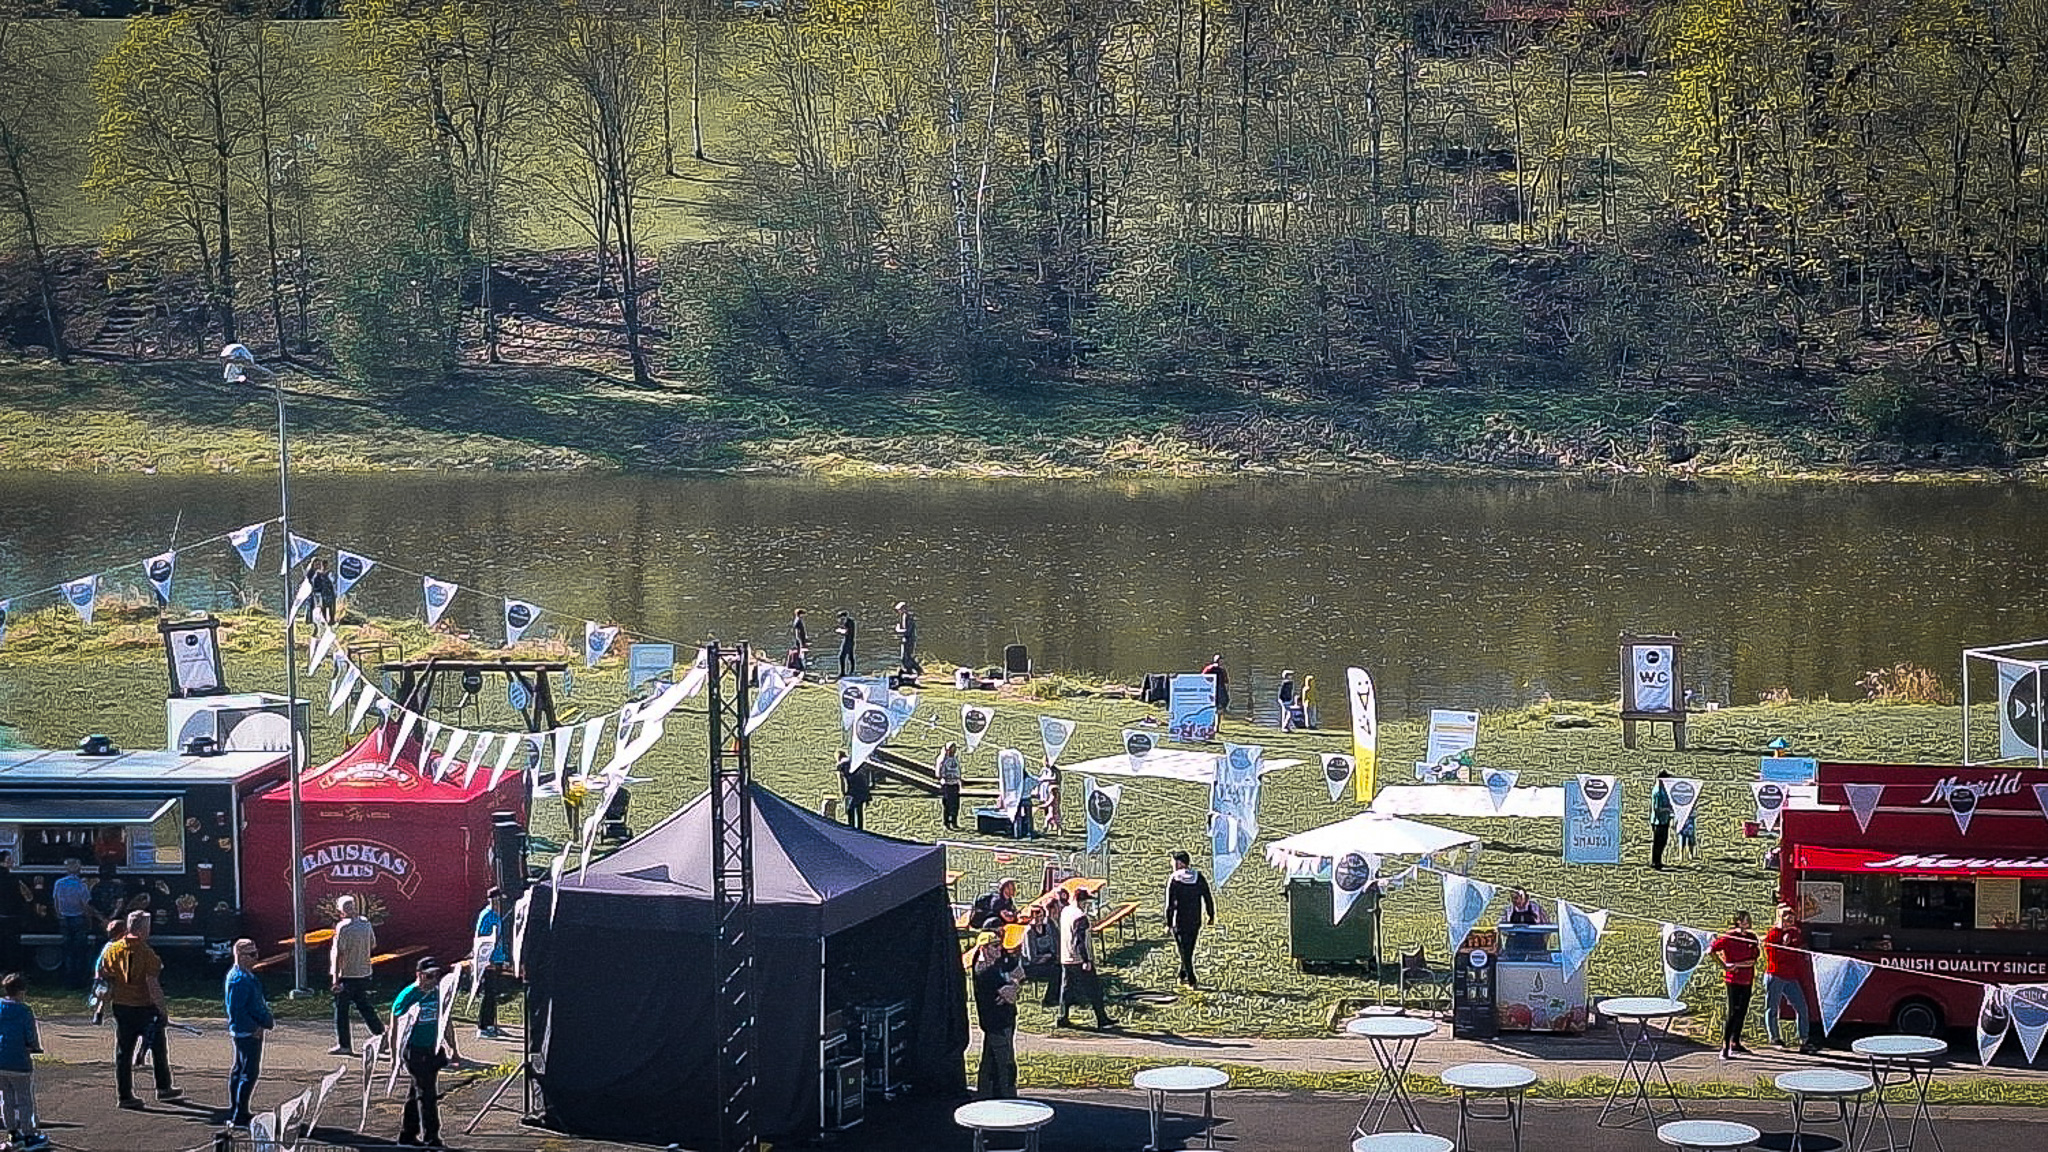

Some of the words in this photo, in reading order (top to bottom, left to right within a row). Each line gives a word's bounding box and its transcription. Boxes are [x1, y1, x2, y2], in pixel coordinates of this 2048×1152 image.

[1639, 671, 1669, 684] WC
[331, 864, 374, 877] ALUS
[1880, 957, 1935, 971] DANISH
[1938, 959, 2001, 973] QUALITY
[2003, 961, 2047, 975] SINCE
